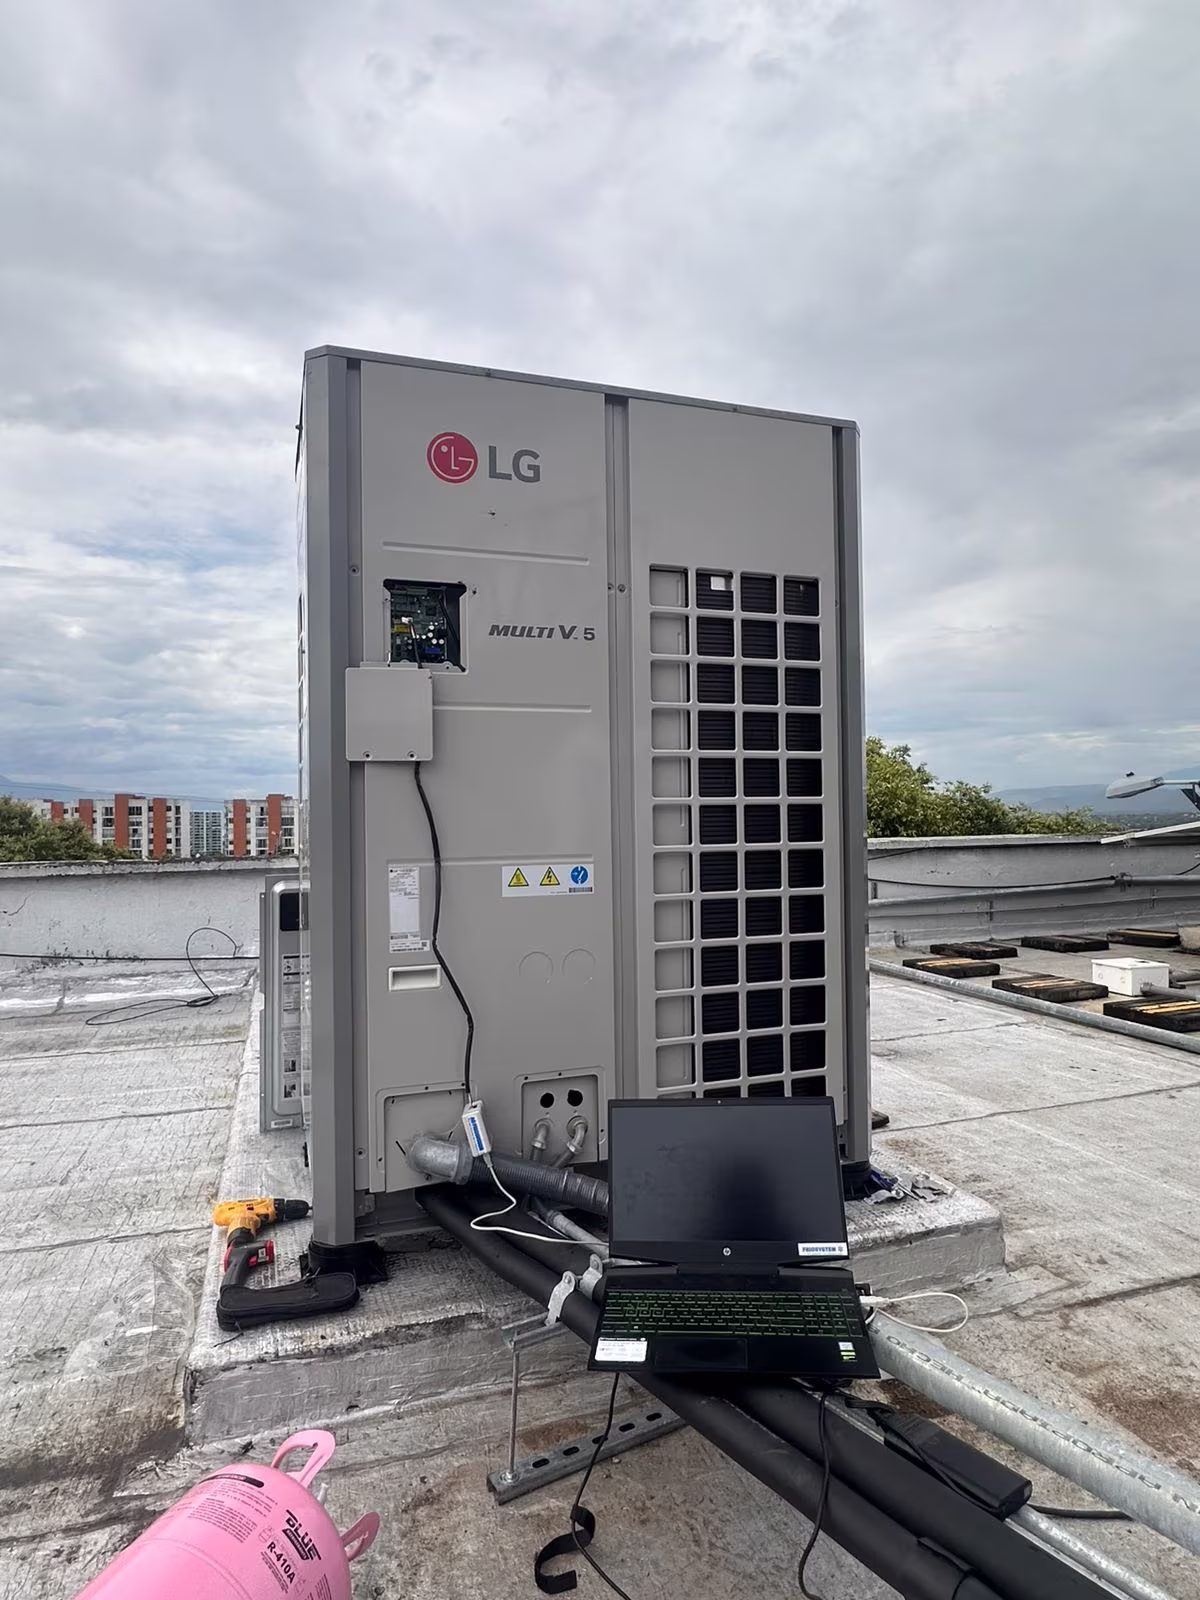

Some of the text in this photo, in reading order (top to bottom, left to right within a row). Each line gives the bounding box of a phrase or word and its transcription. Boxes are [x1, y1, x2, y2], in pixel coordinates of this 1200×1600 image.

[488, 445, 541, 483] LG
[488, 624, 555, 639] MULTI
[583, 627, 596, 641] 5
[886, 1335, 963, 1382] HECHO
[266, 1541, 297, 1585] R-410A
